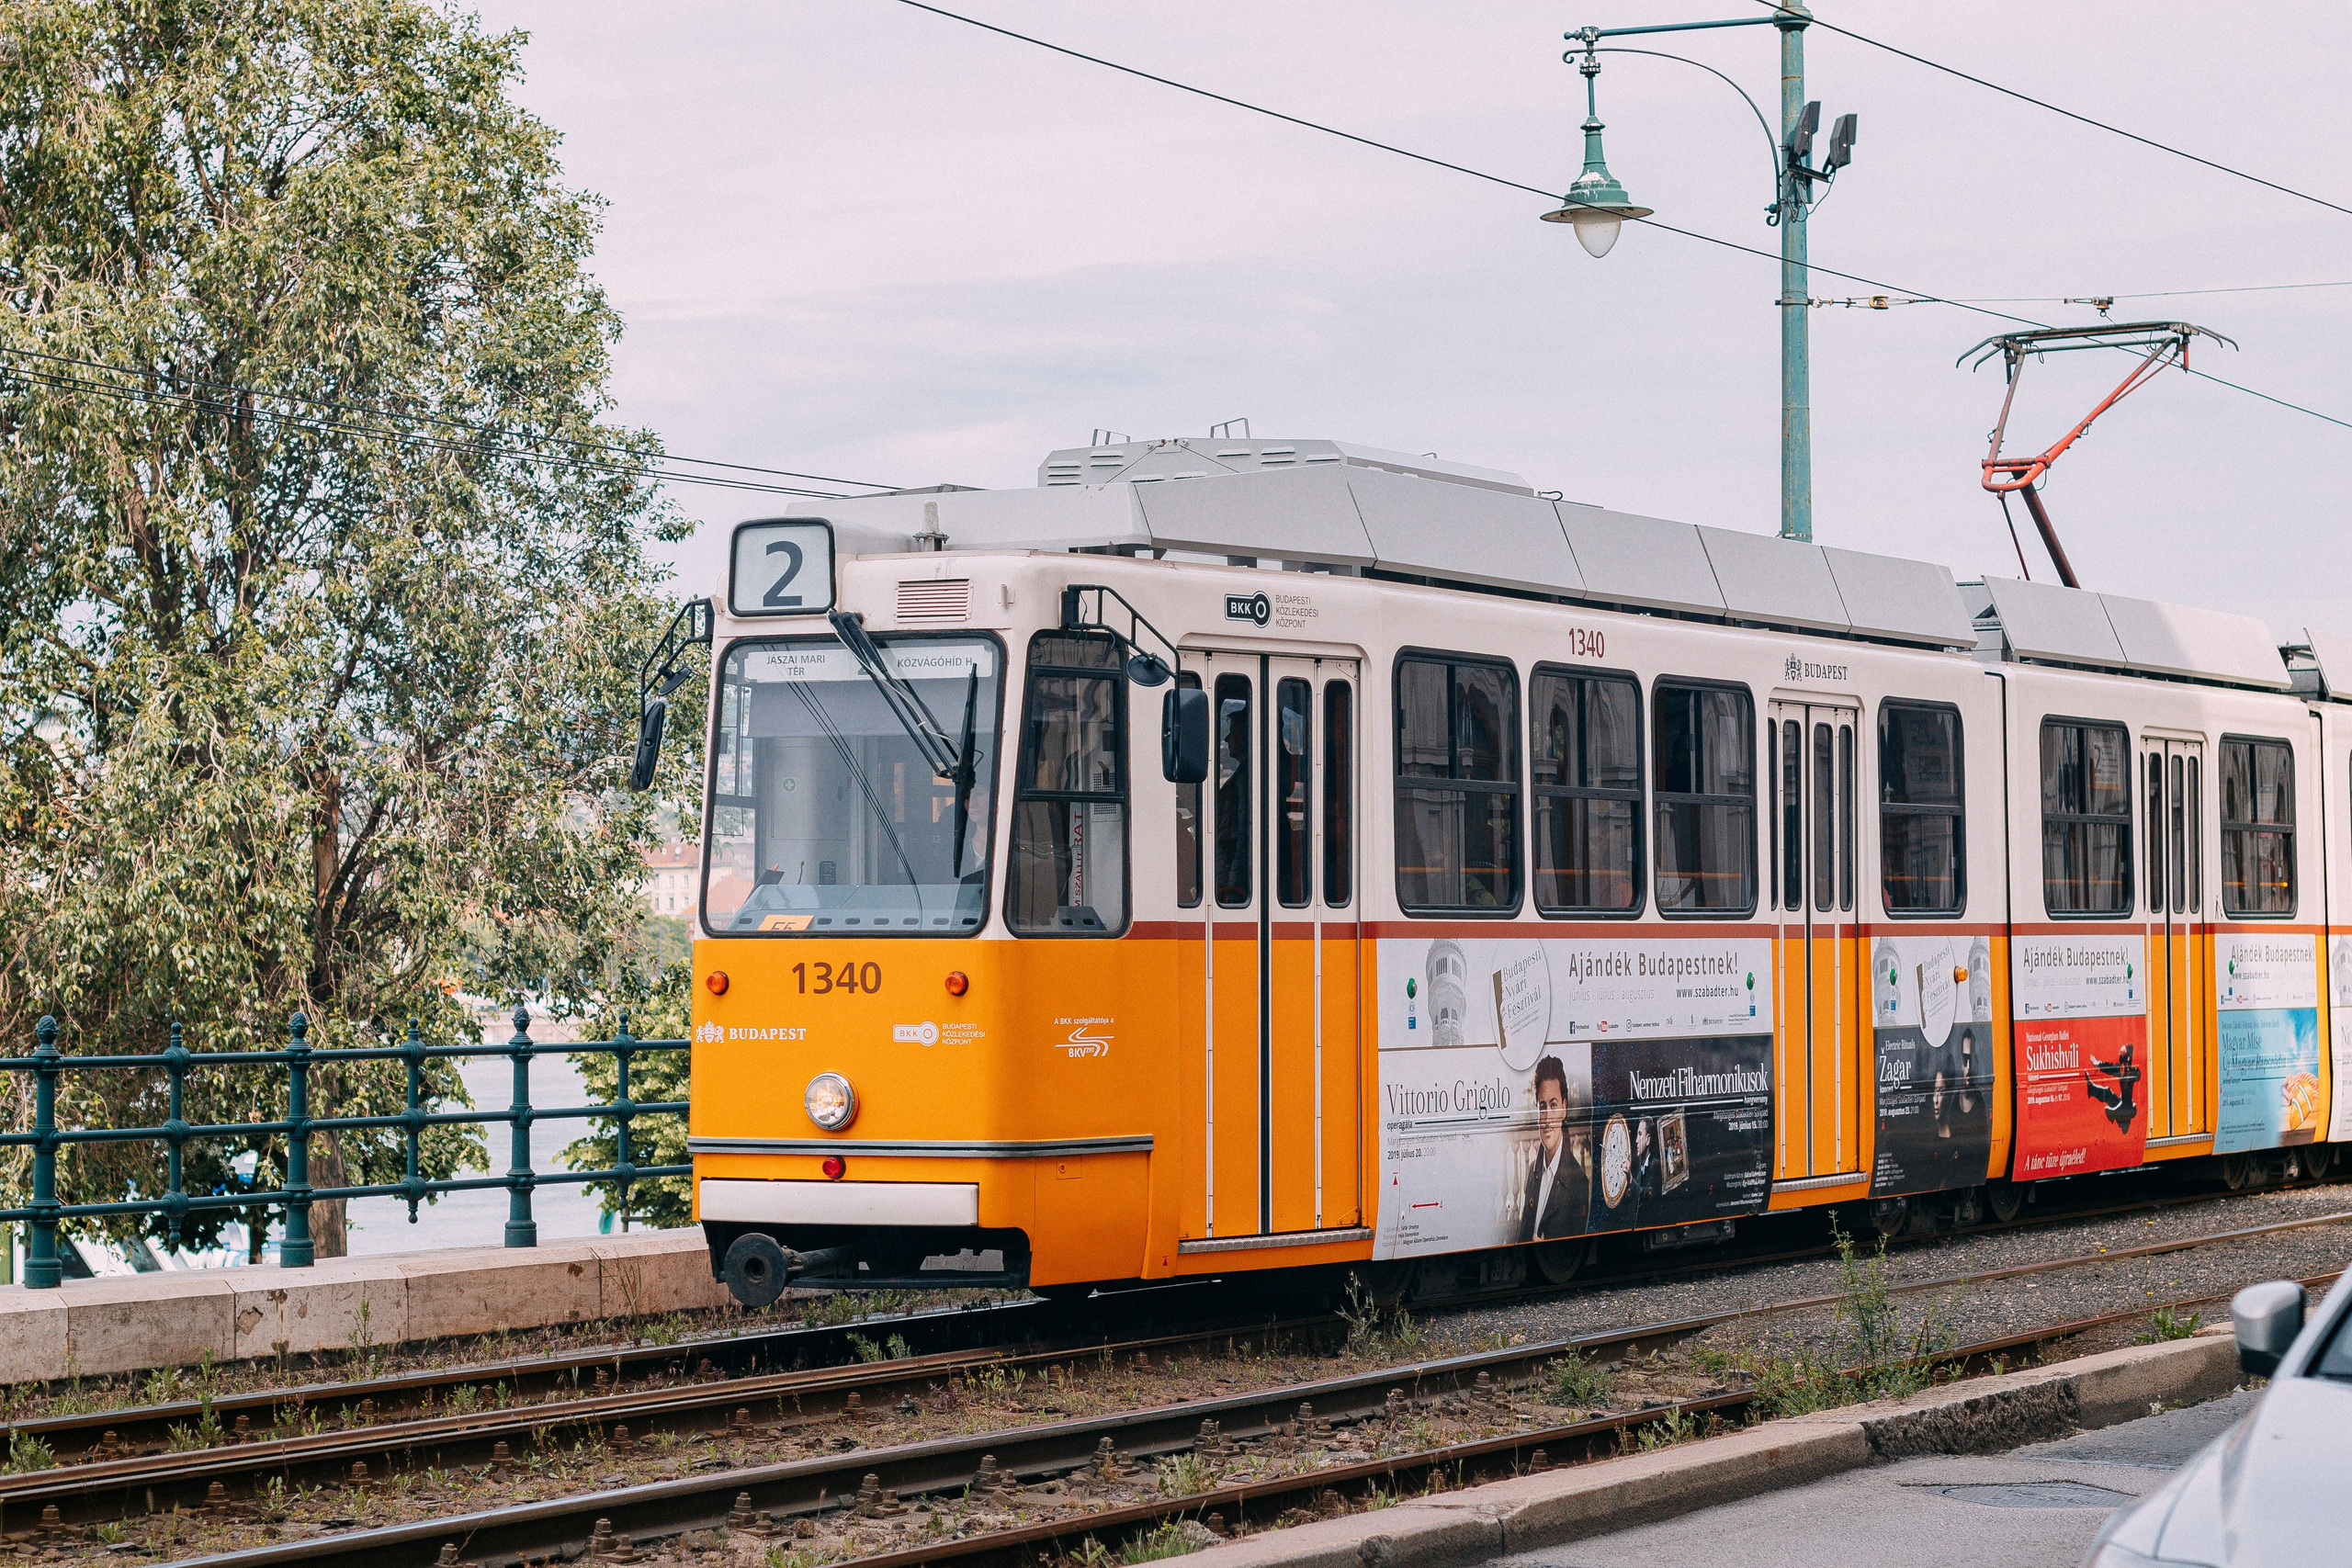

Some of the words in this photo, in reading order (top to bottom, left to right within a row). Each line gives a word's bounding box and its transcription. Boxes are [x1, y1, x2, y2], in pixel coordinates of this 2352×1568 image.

[763, 540, 804, 607] 2
[1231, 602, 1251, 615] BKK
[1275, 594, 1311, 605] BUDAPESTI
[1275, 605, 1319, 617] KÖZLEKEDÉSI
[1275, 617, 1306, 628] KÖZPONT
[1568, 627, 1605, 659] 1340
[766, 653, 797, 665] JÁSZAI
[800, 654, 826, 664] MARI
[897, 655, 963, 668] KÖZVÁGÓHÍD
[787, 665, 805, 676] TÉR
[1804, 662, 1849, 682] BUDAPEST
[1502, 946, 1542, 982] Budapesti
[1923, 942, 1951, 974] Budapesti
[2023, 946, 2064, 974] Ajándék
[2066, 945, 2129, 972] Budapestnek!
[2232, 943, 2263, 968] Ajándék
[2266, 943, 2315, 967] Budapestnek!
[1568, 951, 1633, 985] Ajándék
[1639, 951, 1738, 983] Budapestnek!
[792, 962, 882, 994] 1340
[1505, 975, 1527, 1001] Nyári
[1568, 987, 1590, 1005] június
[1597, 987, 1615, 1004] július
[1622, 988, 1655, 1003] augusztus
[1676, 985, 1739, 998] www.szabadter.hu
[1928, 975, 1951, 1005] Fesztivál
[1507, 985, 1542, 1020] Fesztivál
[1060, 1017, 1072, 1025] BKK
[1073, 1016, 1109, 1026] szolgáltatója
[729, 1027, 807, 1040] BUDAPEST
[899, 1030, 919, 1038] BKK
[942, 1030, 986, 1038] KÖZLEKEDÉSI
[1069, 1047, 1085, 1057] BKV
[2026, 1043, 2079, 1072] Sukhishvili
[1629, 1069, 1677, 1100] Nemzeti
[1678, 1062, 1769, 1097] Filharmonikusok
[1385, 1082, 1449, 1115] Vittorio
[1453, 1077, 1511, 1121] Grigolo
[1386, 1119, 1413, 1133] operagála
[2024, 1155, 2030, 1171] A
[2030, 1153, 2045, 1170] tánc
